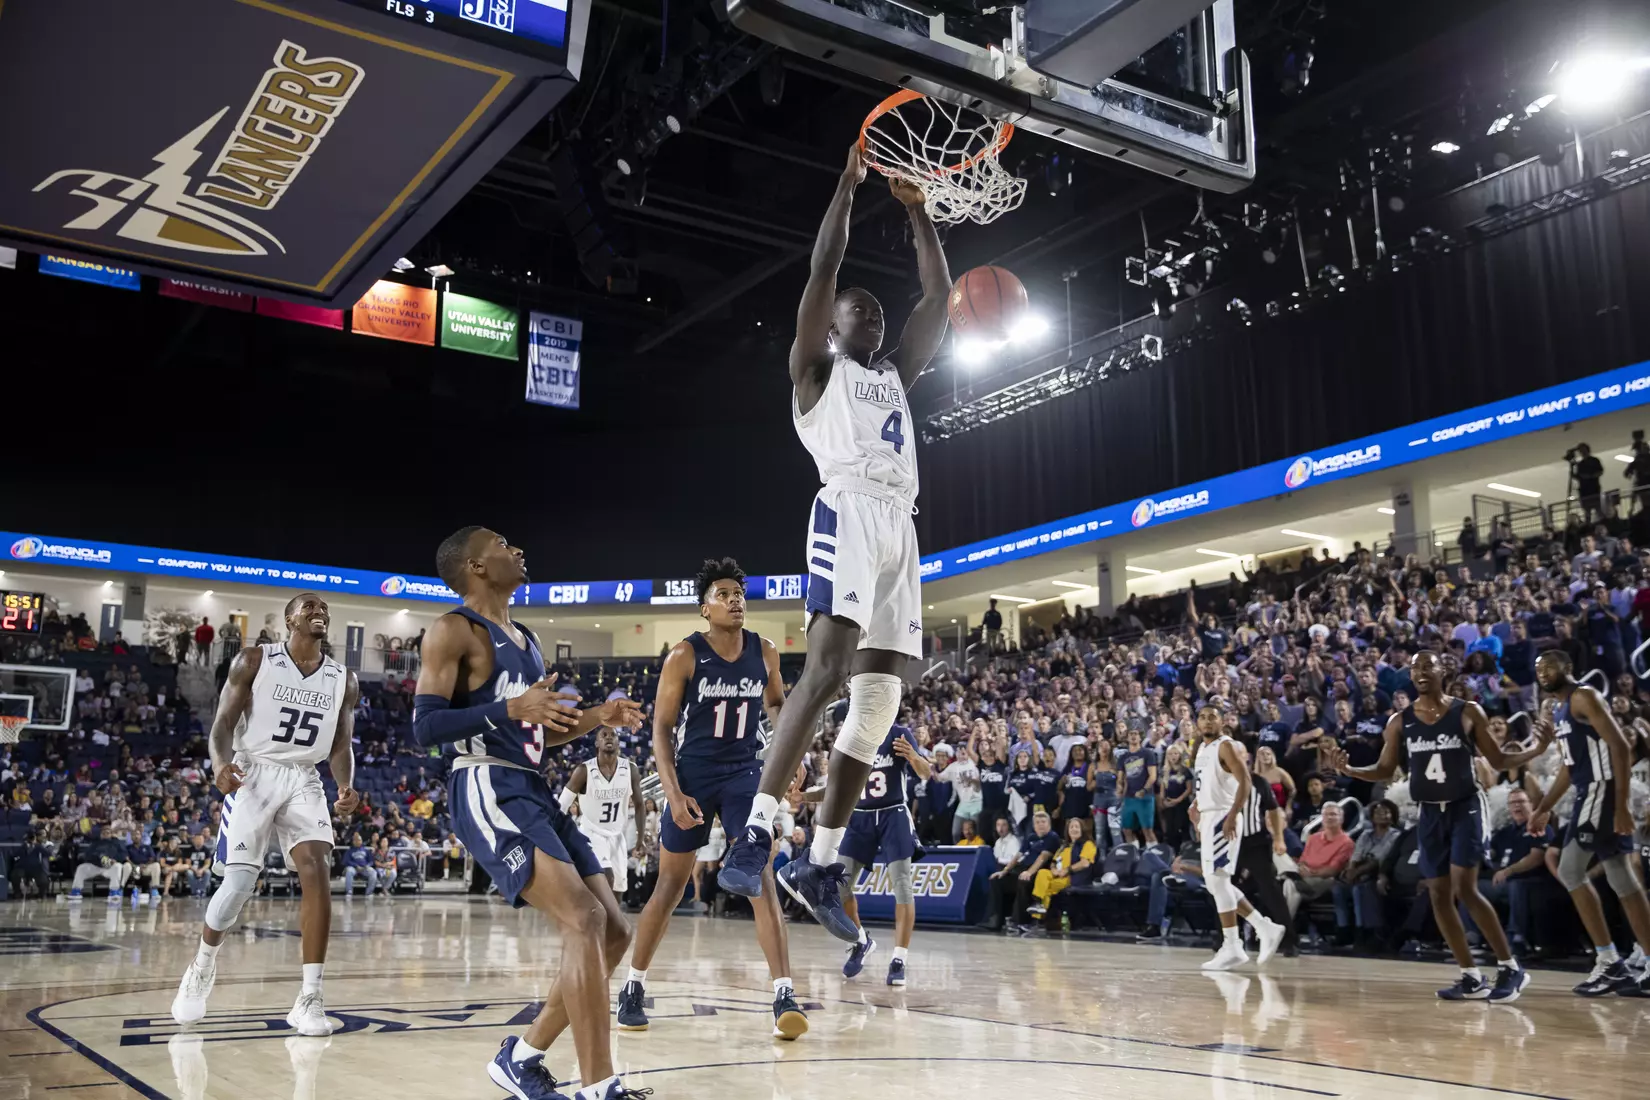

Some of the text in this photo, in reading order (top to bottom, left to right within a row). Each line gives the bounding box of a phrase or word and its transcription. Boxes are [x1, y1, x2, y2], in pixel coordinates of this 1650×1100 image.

[386, 0, 435, 23] FLS 3
[195, 39, 365, 210] LANCERS
[358, 302, 431, 321] GRANDE VALLEY
[372, 295, 419, 309] TEXAS RIO
[368, 314, 421, 328] UNIVERSITY
[447, 310, 516, 331] UTAH VALLEY
[540, 318, 573, 335] CBI
[450, 322, 512, 342] UNIVERSITY
[544, 336, 567, 348] 2019
[541, 351, 570, 364] MEN'S
[533, 364, 577, 388] CBU
[1431, 375, 1650, 443] COMFORT YOU WANT TO GO HOM
[881, 410, 904, 454] 4
[1313, 444, 1381, 471] MAGNOLIA
[1154, 490, 1209, 511] MAGNOLIA
[43, 544, 111, 559] MAGNOLIA
[967, 521, 1098, 562] COMFORT YOU WANT TO GO HOME TO
[158, 557, 342, 584] COMFORT YOU WANT TO GO HOME TO
[405, 580, 457, 595] MAGNOL
[549, 585, 589, 604] CBU
[615, 582, 634, 602] 49
[5, 594, 40, 609] 15:51
[2, 607, 33, 630] 21
[273, 684, 332, 710] LANCERS
[698, 677, 763, 703] Jackson State
[272, 706, 324, 747] 35
[714, 700, 748, 739] 11
[520, 719, 544, 766] 3
[1437, 733, 1461, 750] State
[1425, 753, 1447, 783] 4
[599, 802, 620, 823] 31
[851, 863, 960, 897] LANERS
